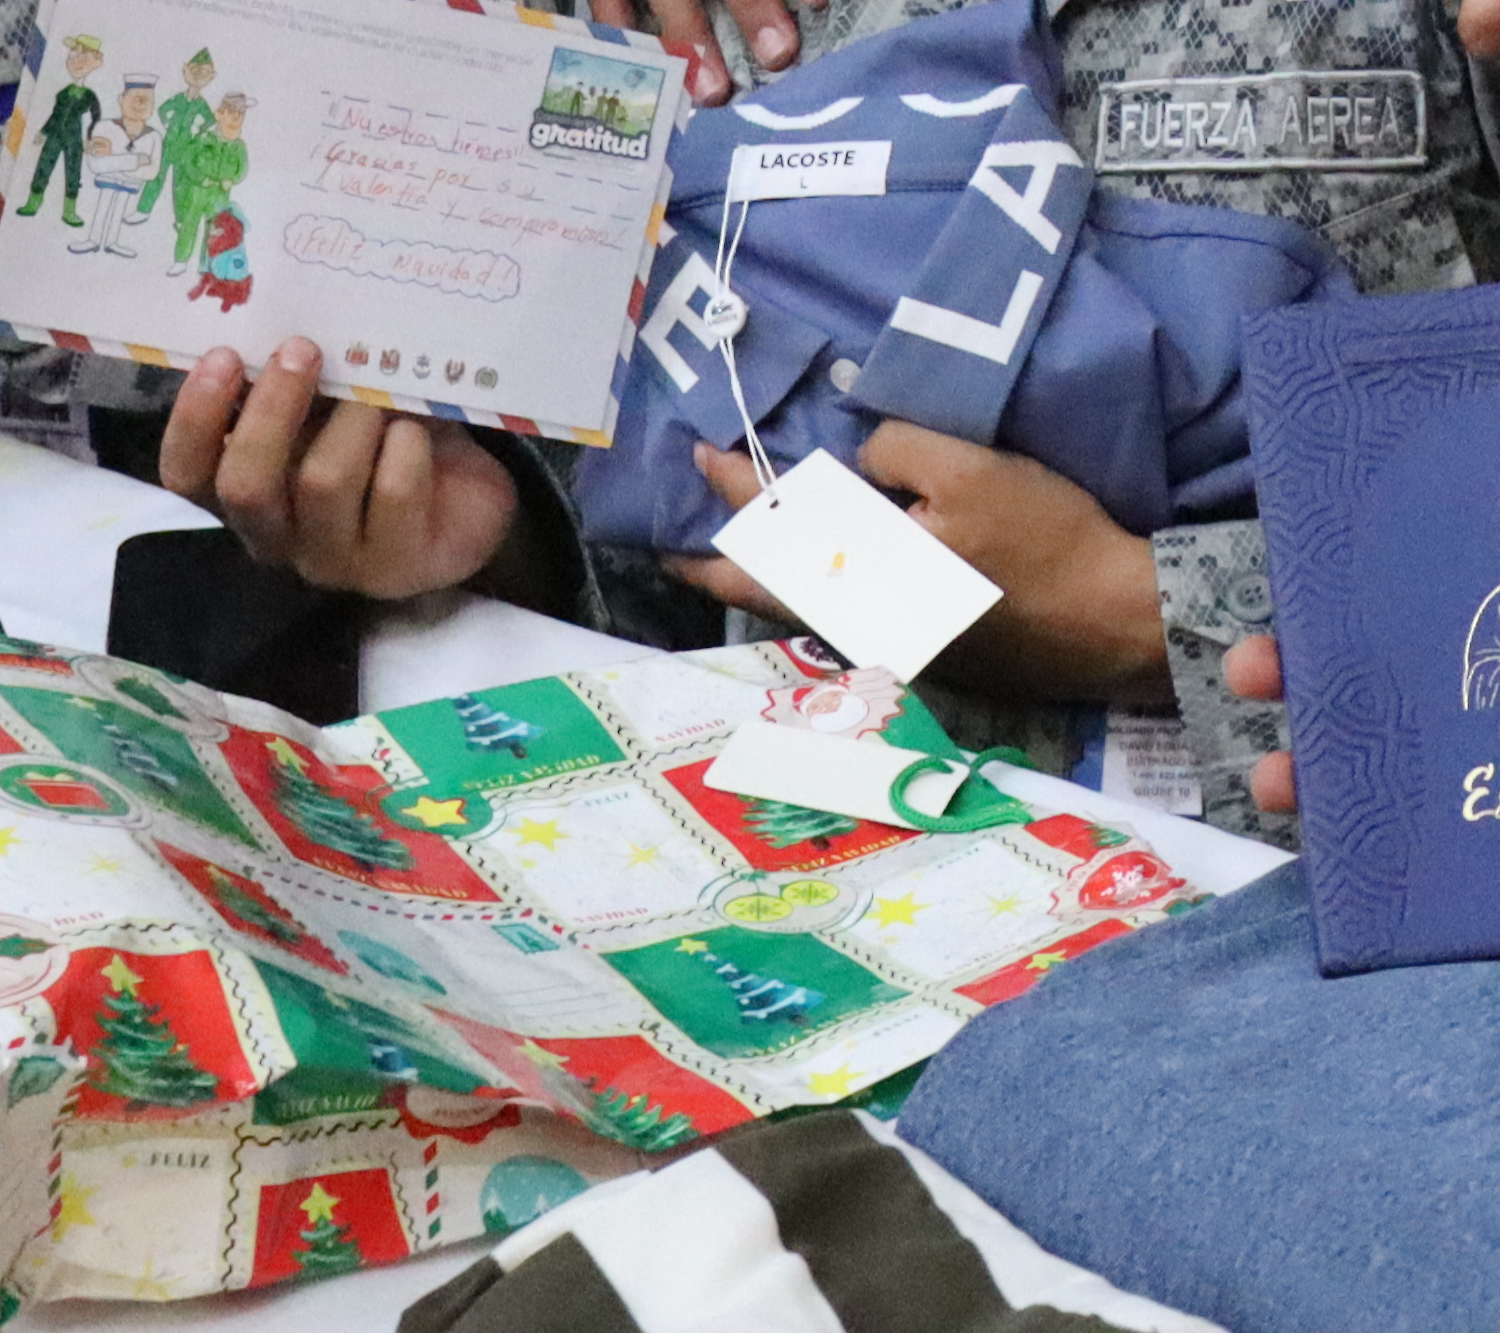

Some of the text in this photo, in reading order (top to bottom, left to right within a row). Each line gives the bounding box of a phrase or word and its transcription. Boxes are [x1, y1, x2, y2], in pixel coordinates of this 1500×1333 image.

[1119, 95, 1401, 152] FUERZA AEREA
[531, 122, 649, 159] gratitud
[759, 150, 858, 169] LACOSTE
[799, 176, 808, 190] L
[654, 718, 726, 744] NAVIDAD
[150, 1151, 211, 1169] FELIZ
